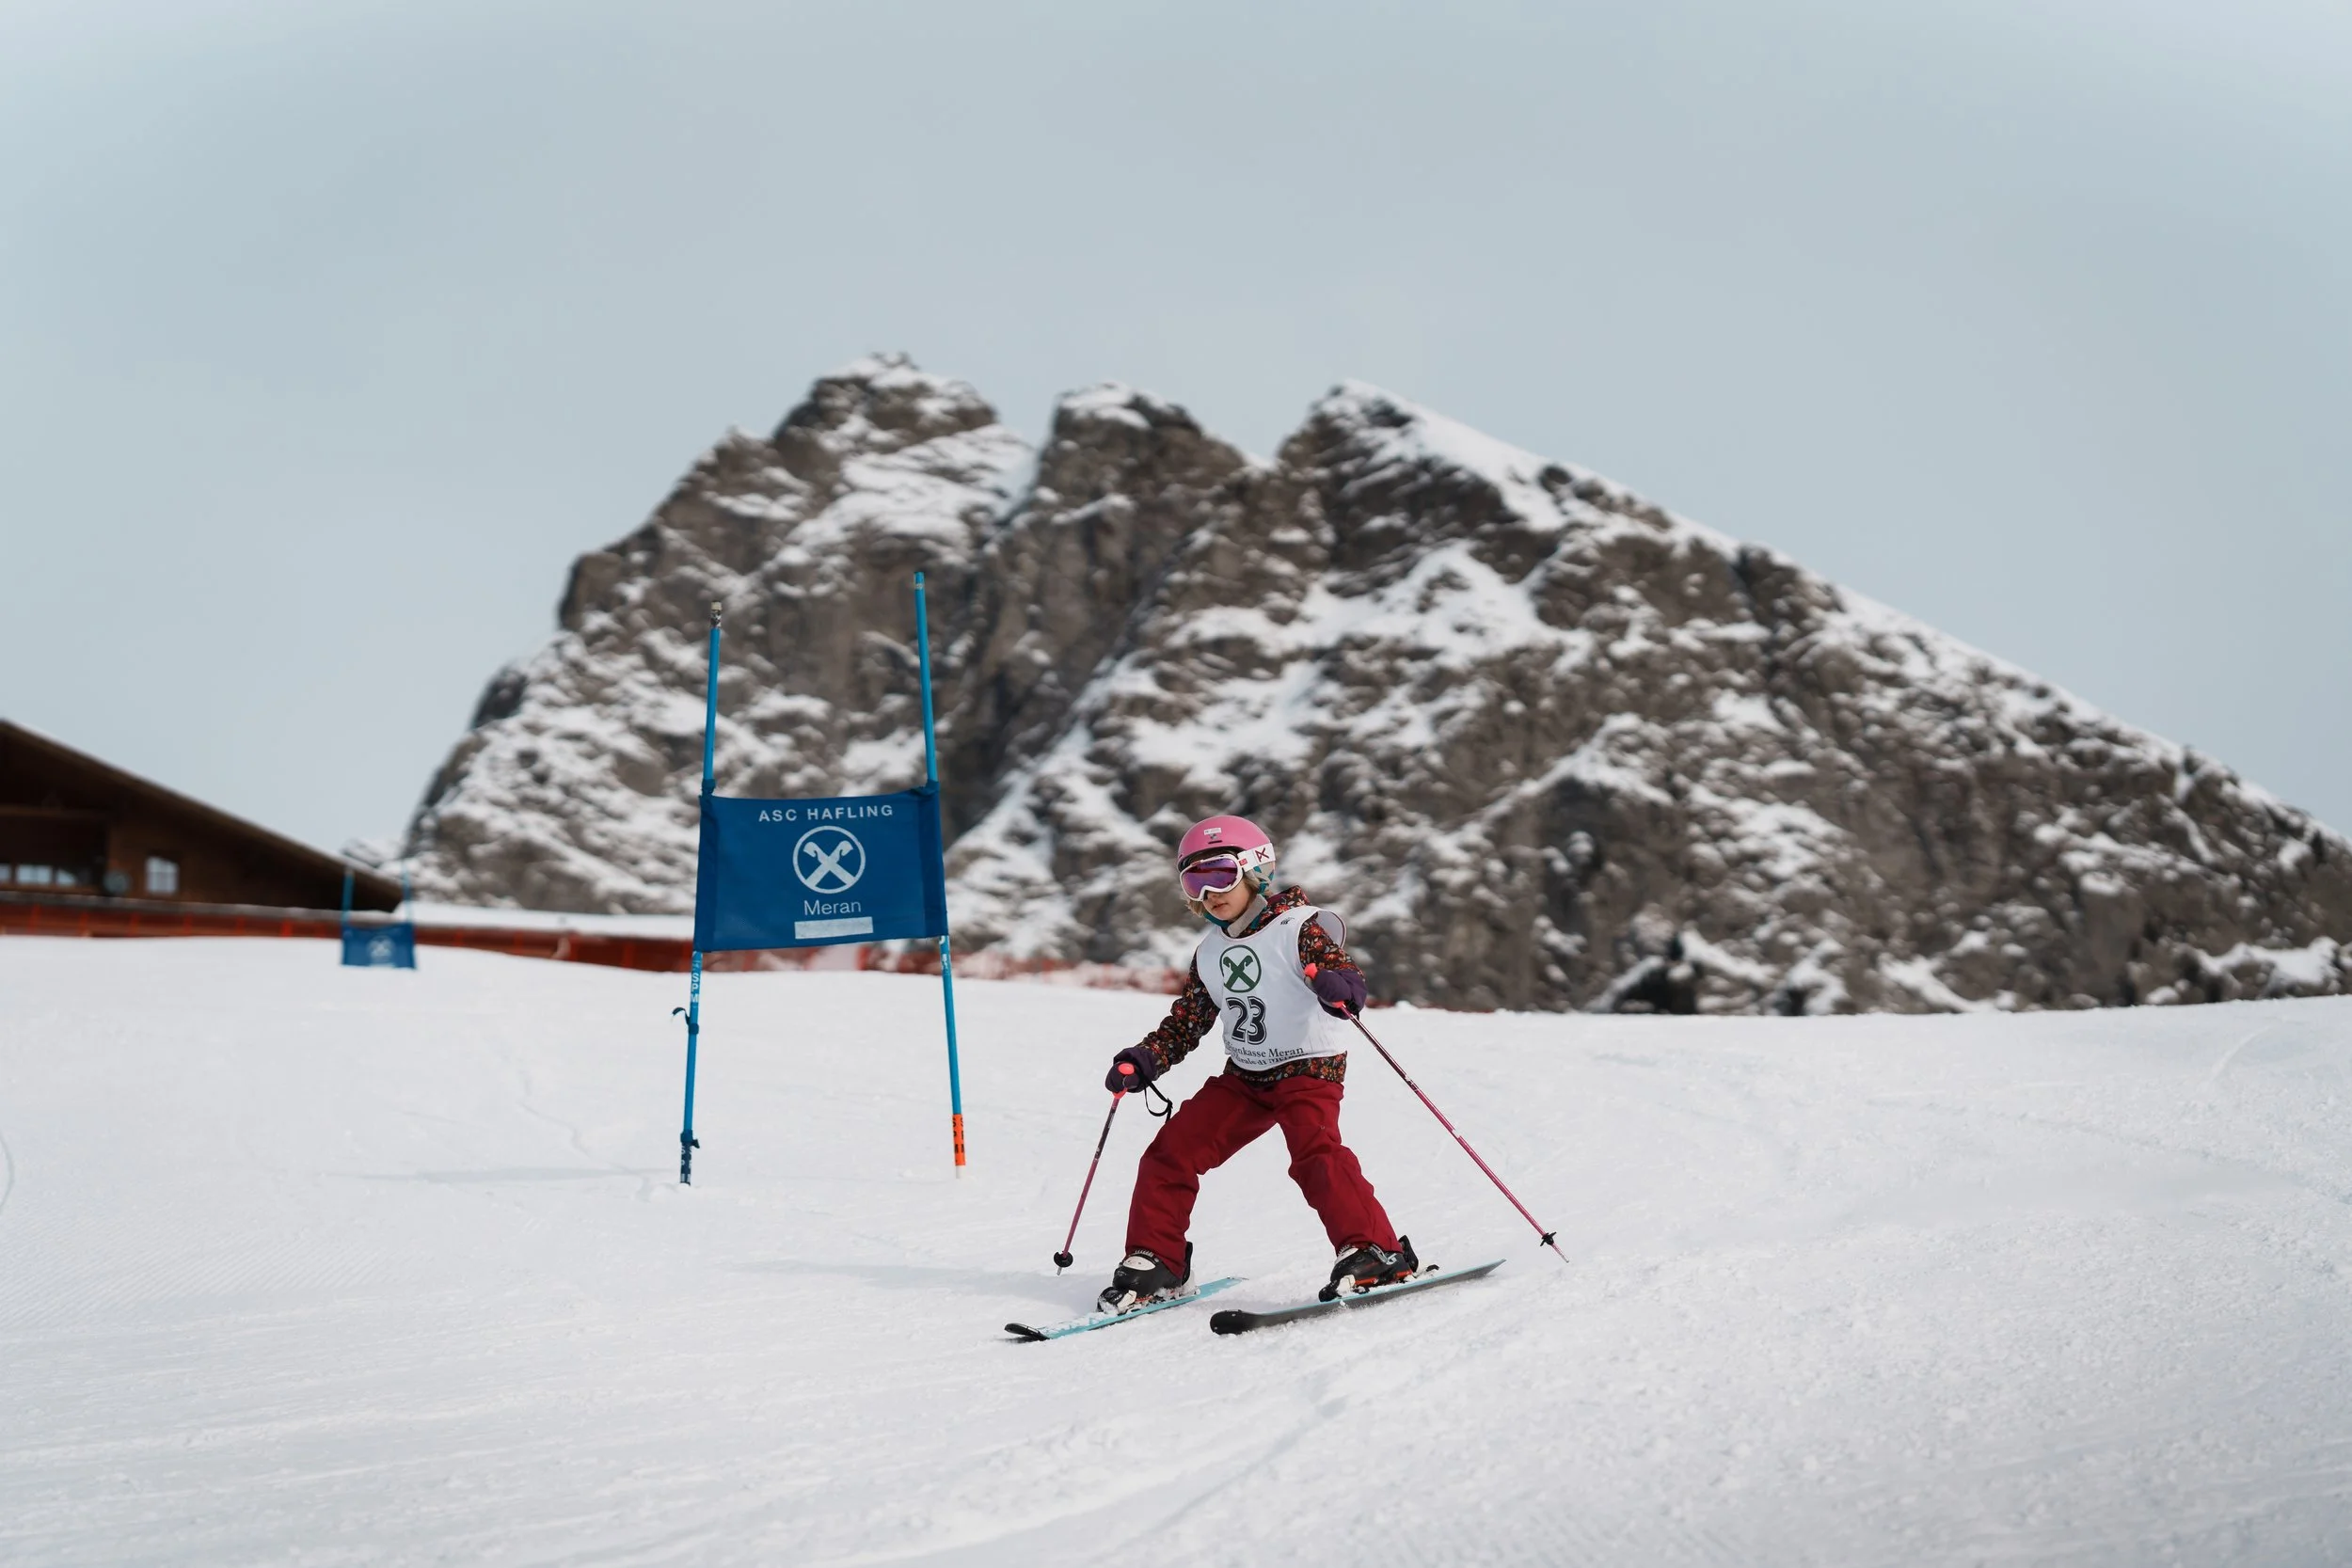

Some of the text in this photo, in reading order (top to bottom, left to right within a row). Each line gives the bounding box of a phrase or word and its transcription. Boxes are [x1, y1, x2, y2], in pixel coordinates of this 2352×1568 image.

[758, 804, 893, 822] ASC HAFLING
[803, 900, 862, 916] Meran
[1226, 996, 1267, 1045] 23
[1268, 1047, 1304, 1057] Meran
